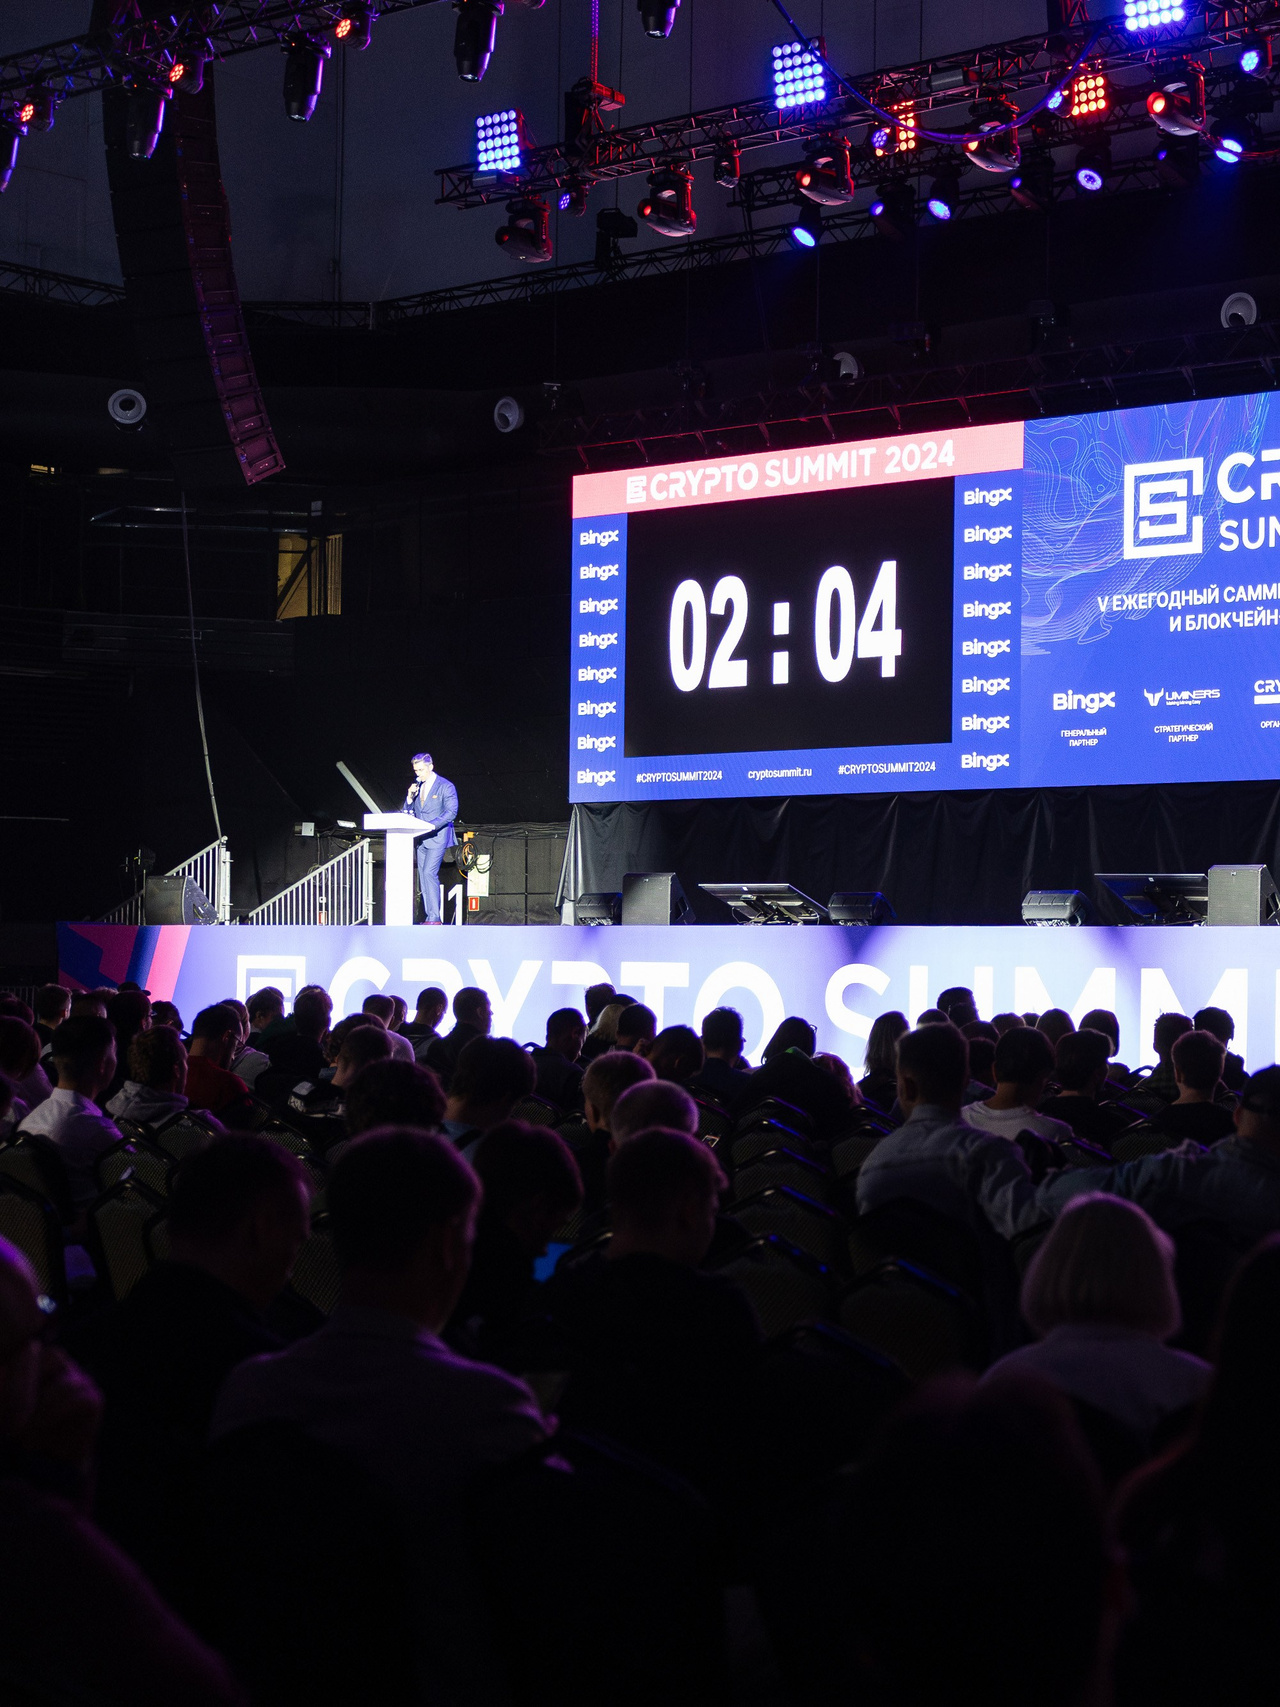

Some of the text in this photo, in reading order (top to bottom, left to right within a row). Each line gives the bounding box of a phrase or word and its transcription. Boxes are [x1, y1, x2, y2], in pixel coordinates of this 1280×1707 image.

[650, 439, 956, 501] CRYPTO SUMMIT 2024
[1096, 595, 1110, 613] V
[1112, 583, 1220, 612] ЕЖЕГОДНЫЙ
[669, 575, 749, 692] 02
[814, 560, 903, 683] 04
[1169, 615, 1182, 633] И
[1165, 688, 1221, 701] UMINERS
[1060, 726, 1107, 738] ГЕНЕРАЛЬНЫЙ
[1153, 722, 1214, 734] СТРАТЕГИЧЕСКИЙ
[1069, 738, 1099, 747] ПАРТНЕР
[1168, 733, 1199, 743] ПАРТНЕР
[635, 760, 937, 784] #CRYPTOSUMMIT2024 cryptosummit.ru #CRYPTOSUMMIT2024
